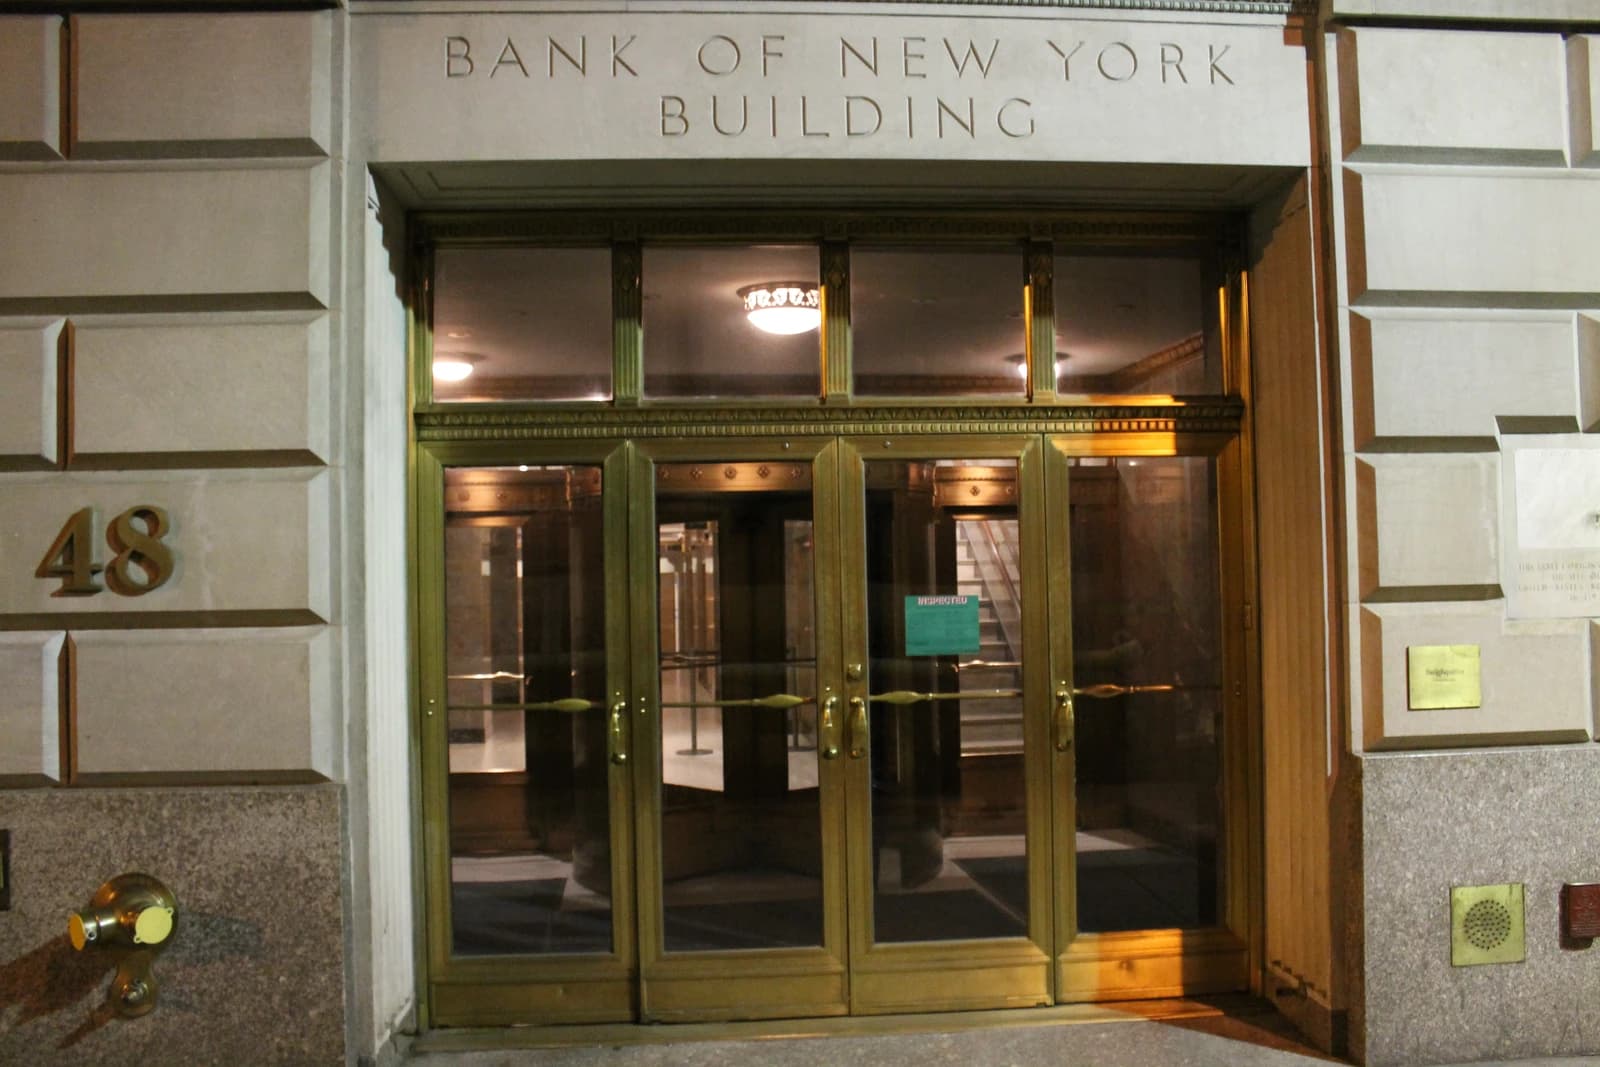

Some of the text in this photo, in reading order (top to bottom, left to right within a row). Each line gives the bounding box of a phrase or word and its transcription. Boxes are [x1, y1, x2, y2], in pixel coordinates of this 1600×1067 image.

[444, 35, 1235, 87] BANK OF NEW YORK
[659, 94, 1036, 139] BUILDING
[35, 504, 176, 598] 48
